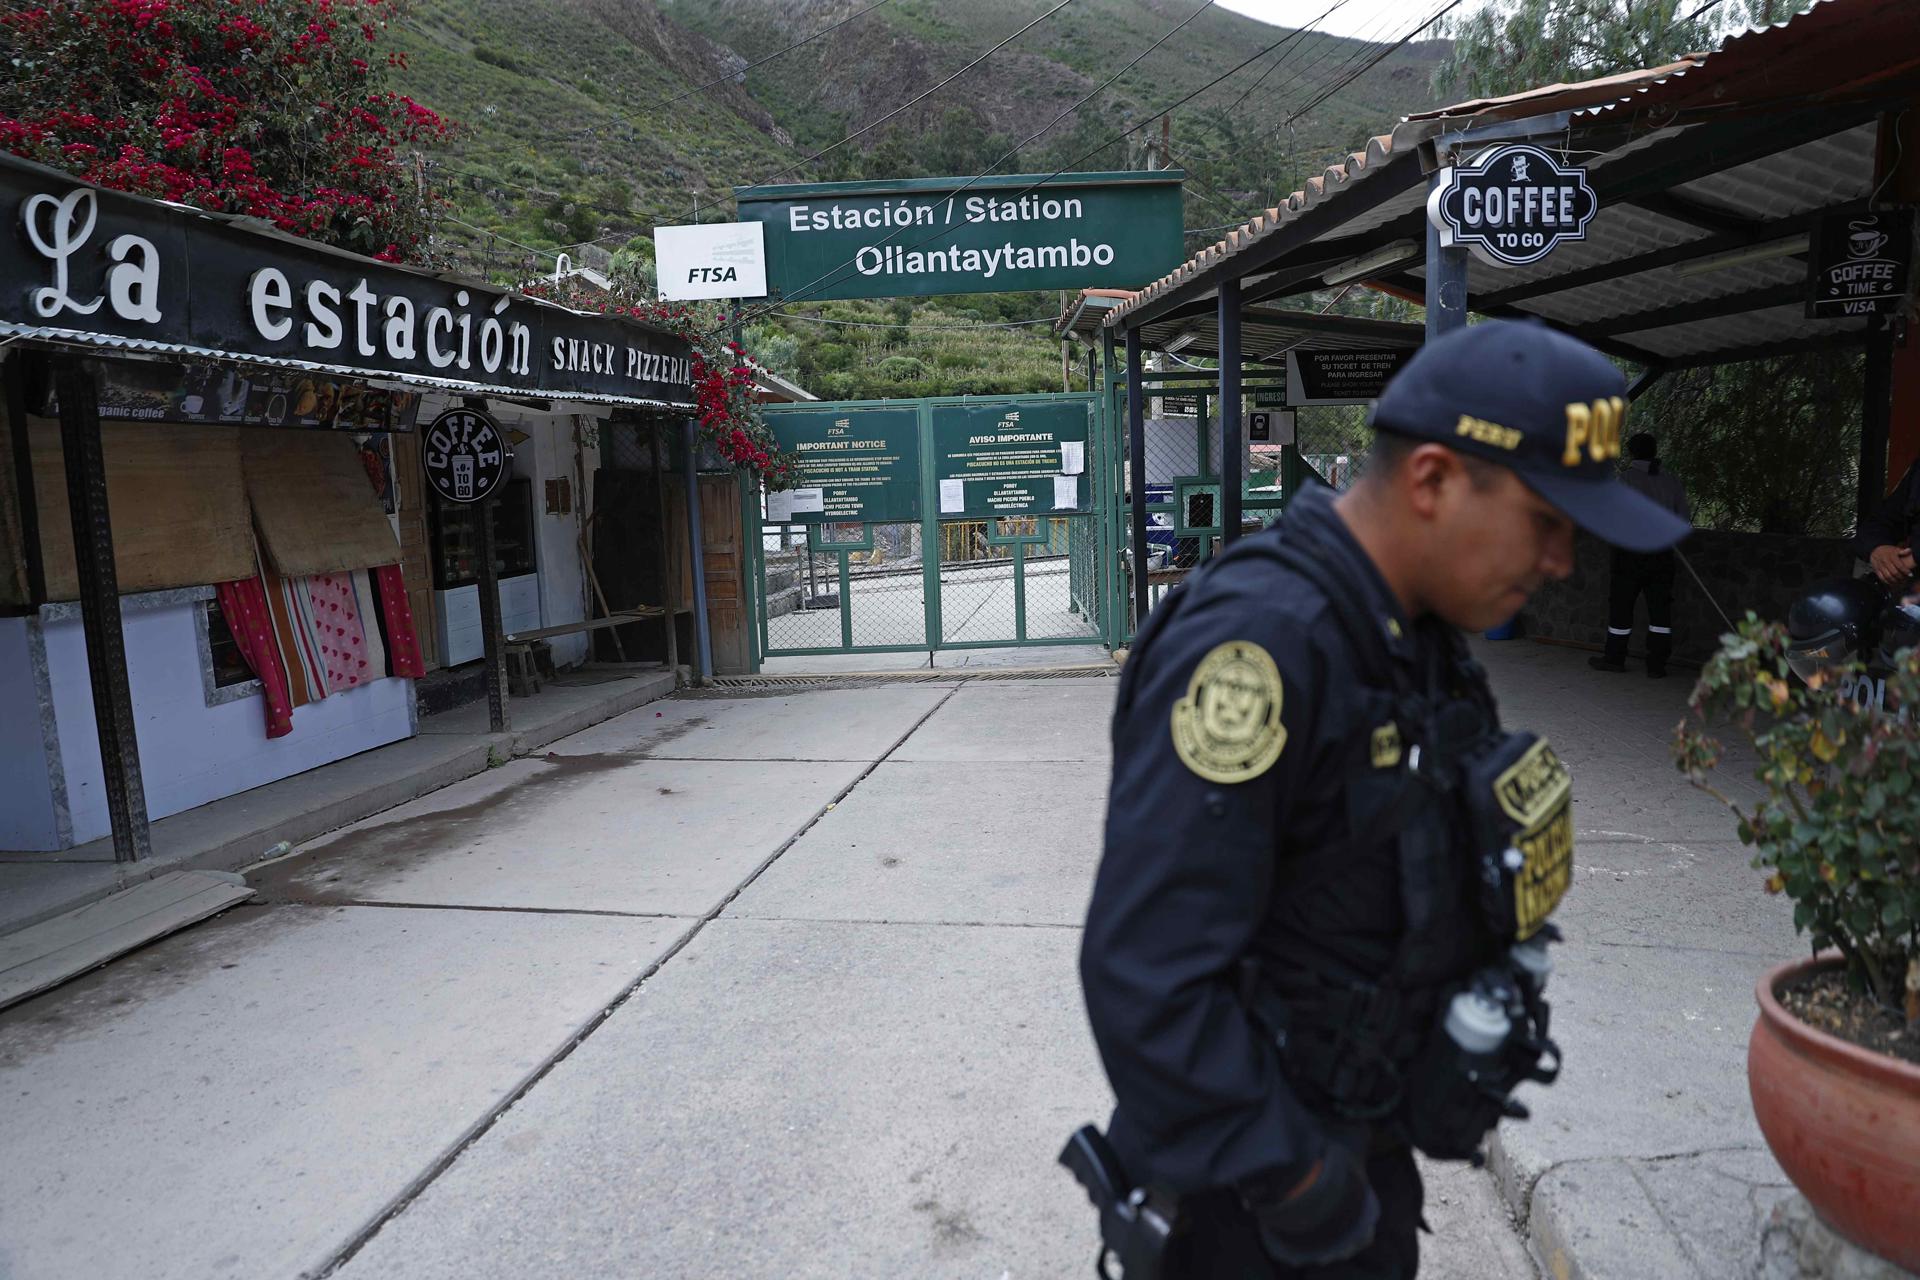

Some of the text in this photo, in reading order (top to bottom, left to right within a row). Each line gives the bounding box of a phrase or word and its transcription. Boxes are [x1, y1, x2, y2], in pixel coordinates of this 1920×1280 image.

[789, 194, 1082, 231] Estación / Station
[1464, 186, 1575, 227] COFFEE
[1497, 233, 1543, 247] TO GO
[856, 238, 1114, 278] Ollantaytambo
[688, 266, 737, 283] FTSA
[1830, 263, 1896, 284] COFFEE
[22, 187, 531, 376] La estación
[1847, 281, 1878, 295] TIME
[1843, 300, 1876, 314] VISA
[551, 336, 690, 386] SNACK PIZZERIA
[98, 405, 129, 417] ganic
[428, 416, 500, 469] COFFEE
[796, 440, 886, 450] IMPORTANT NOTICE
[969, 433, 1053, 444] AVISO IMPORTANTE
[457, 474, 469, 484] TO
[458, 486, 470, 496] GO
